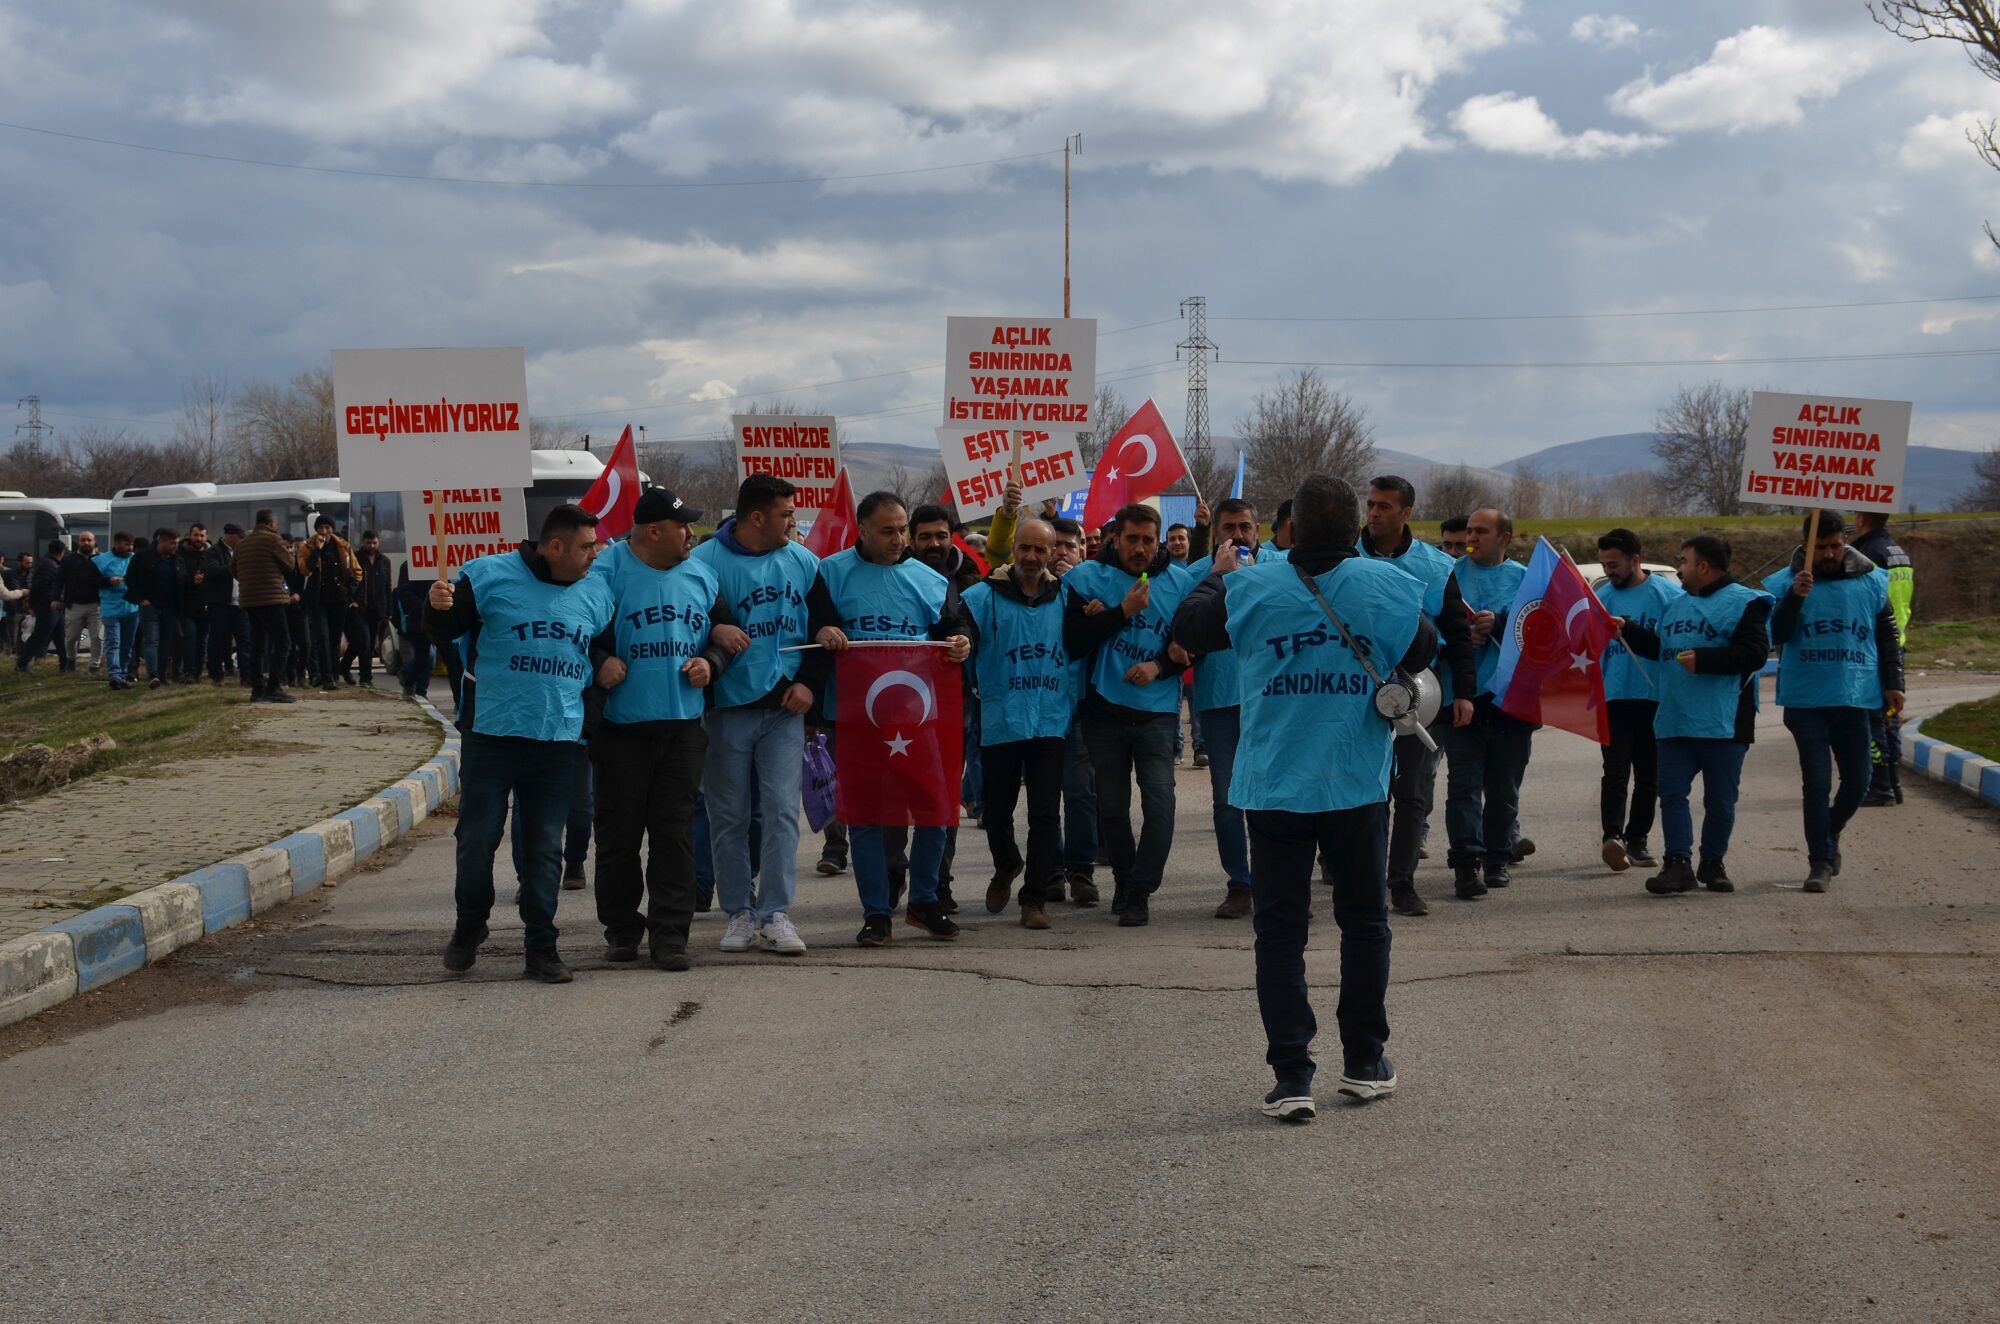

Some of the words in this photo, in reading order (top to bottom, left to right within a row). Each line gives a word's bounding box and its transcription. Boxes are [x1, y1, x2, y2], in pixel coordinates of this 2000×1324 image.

[992, 327, 1051, 349] AÇLIK
[968, 352, 1072, 372] SINIRINDA
[971, 376, 1069, 399] YAŞAMAK
[346, 397, 519, 441] GEÇİNEMİYORUZ
[950, 396, 1088, 422] İSTEMİYORUZ
[1798, 404, 1862, 427] AÇLIK
[742, 421, 830, 448] SAYENİZDE
[1772, 426, 1881, 452] SINIRINDA
[742, 453, 836, 478] TESADÜFEN
[1772, 451, 1876, 476] YAŞAMAK
[957, 468, 1003, 507] EŞİT
[1747, 470, 1894, 503] İSTEMİYORUZ
[625, 604, 704, 633] TES-İŞ
[1664, 617, 1718, 641] TES-İŞ
[1800, 618, 1869, 643] TES-İŞ
[510, 655, 584, 680] SENDİKASI
[1800, 645, 1866, 665] SENDİKASI
